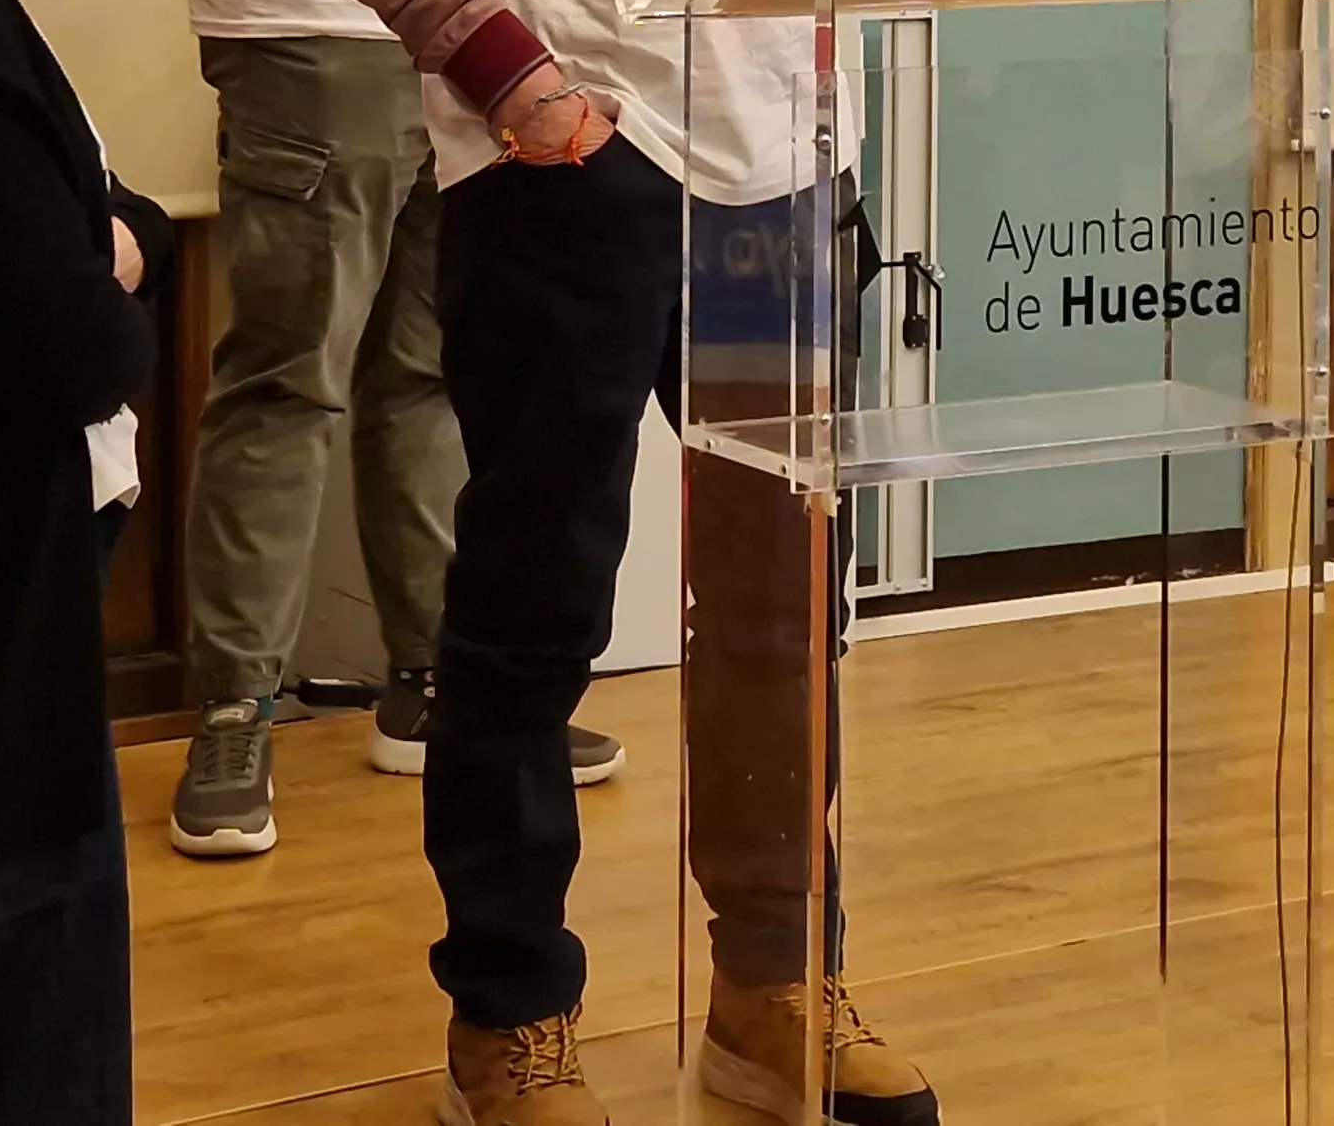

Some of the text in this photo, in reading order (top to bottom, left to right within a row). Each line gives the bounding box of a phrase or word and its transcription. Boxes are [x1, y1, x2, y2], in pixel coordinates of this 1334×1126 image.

[986, 197, 1321, 275] Ayuntamiento
[985, 275, 1241, 334] de Huesca
